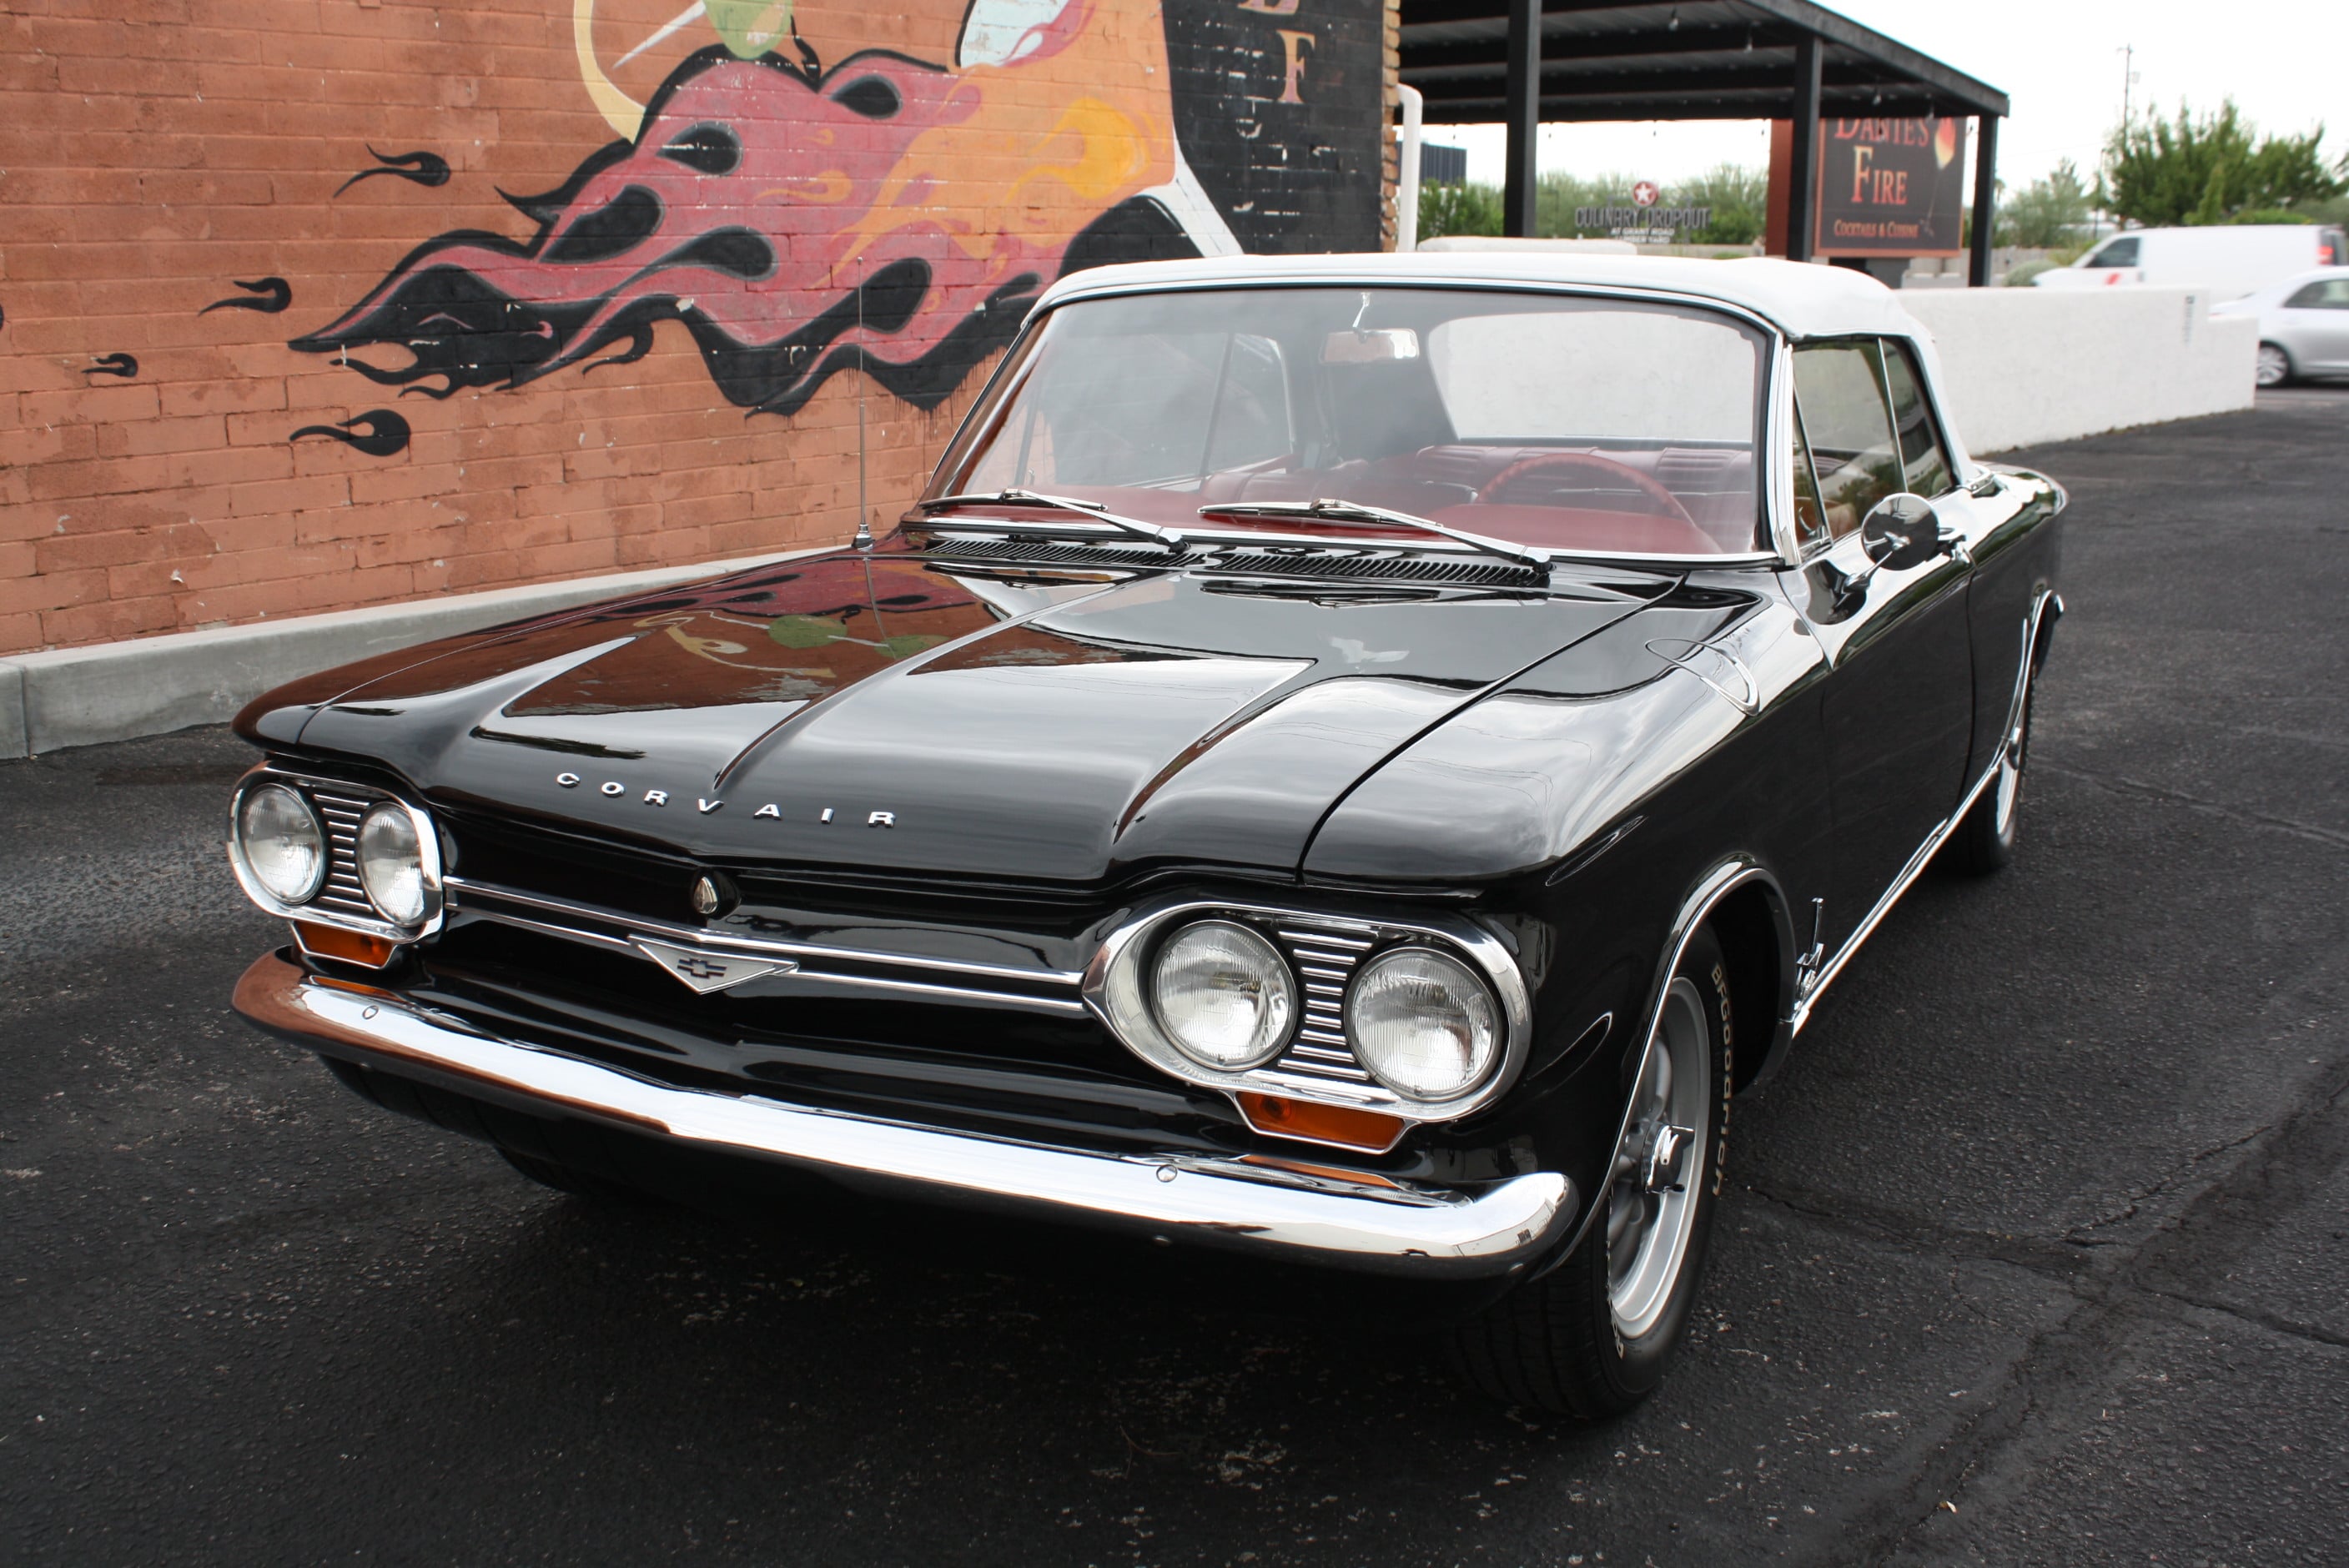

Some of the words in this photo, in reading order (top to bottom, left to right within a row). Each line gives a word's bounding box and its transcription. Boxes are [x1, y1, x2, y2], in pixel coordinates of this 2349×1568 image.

[1851, 144, 1909, 204] FIRE
[1575, 207, 1639, 228] CULINARY
[1646, 208, 1711, 229] DROPOUT
[556, 771, 897, 828] CORVAIR
